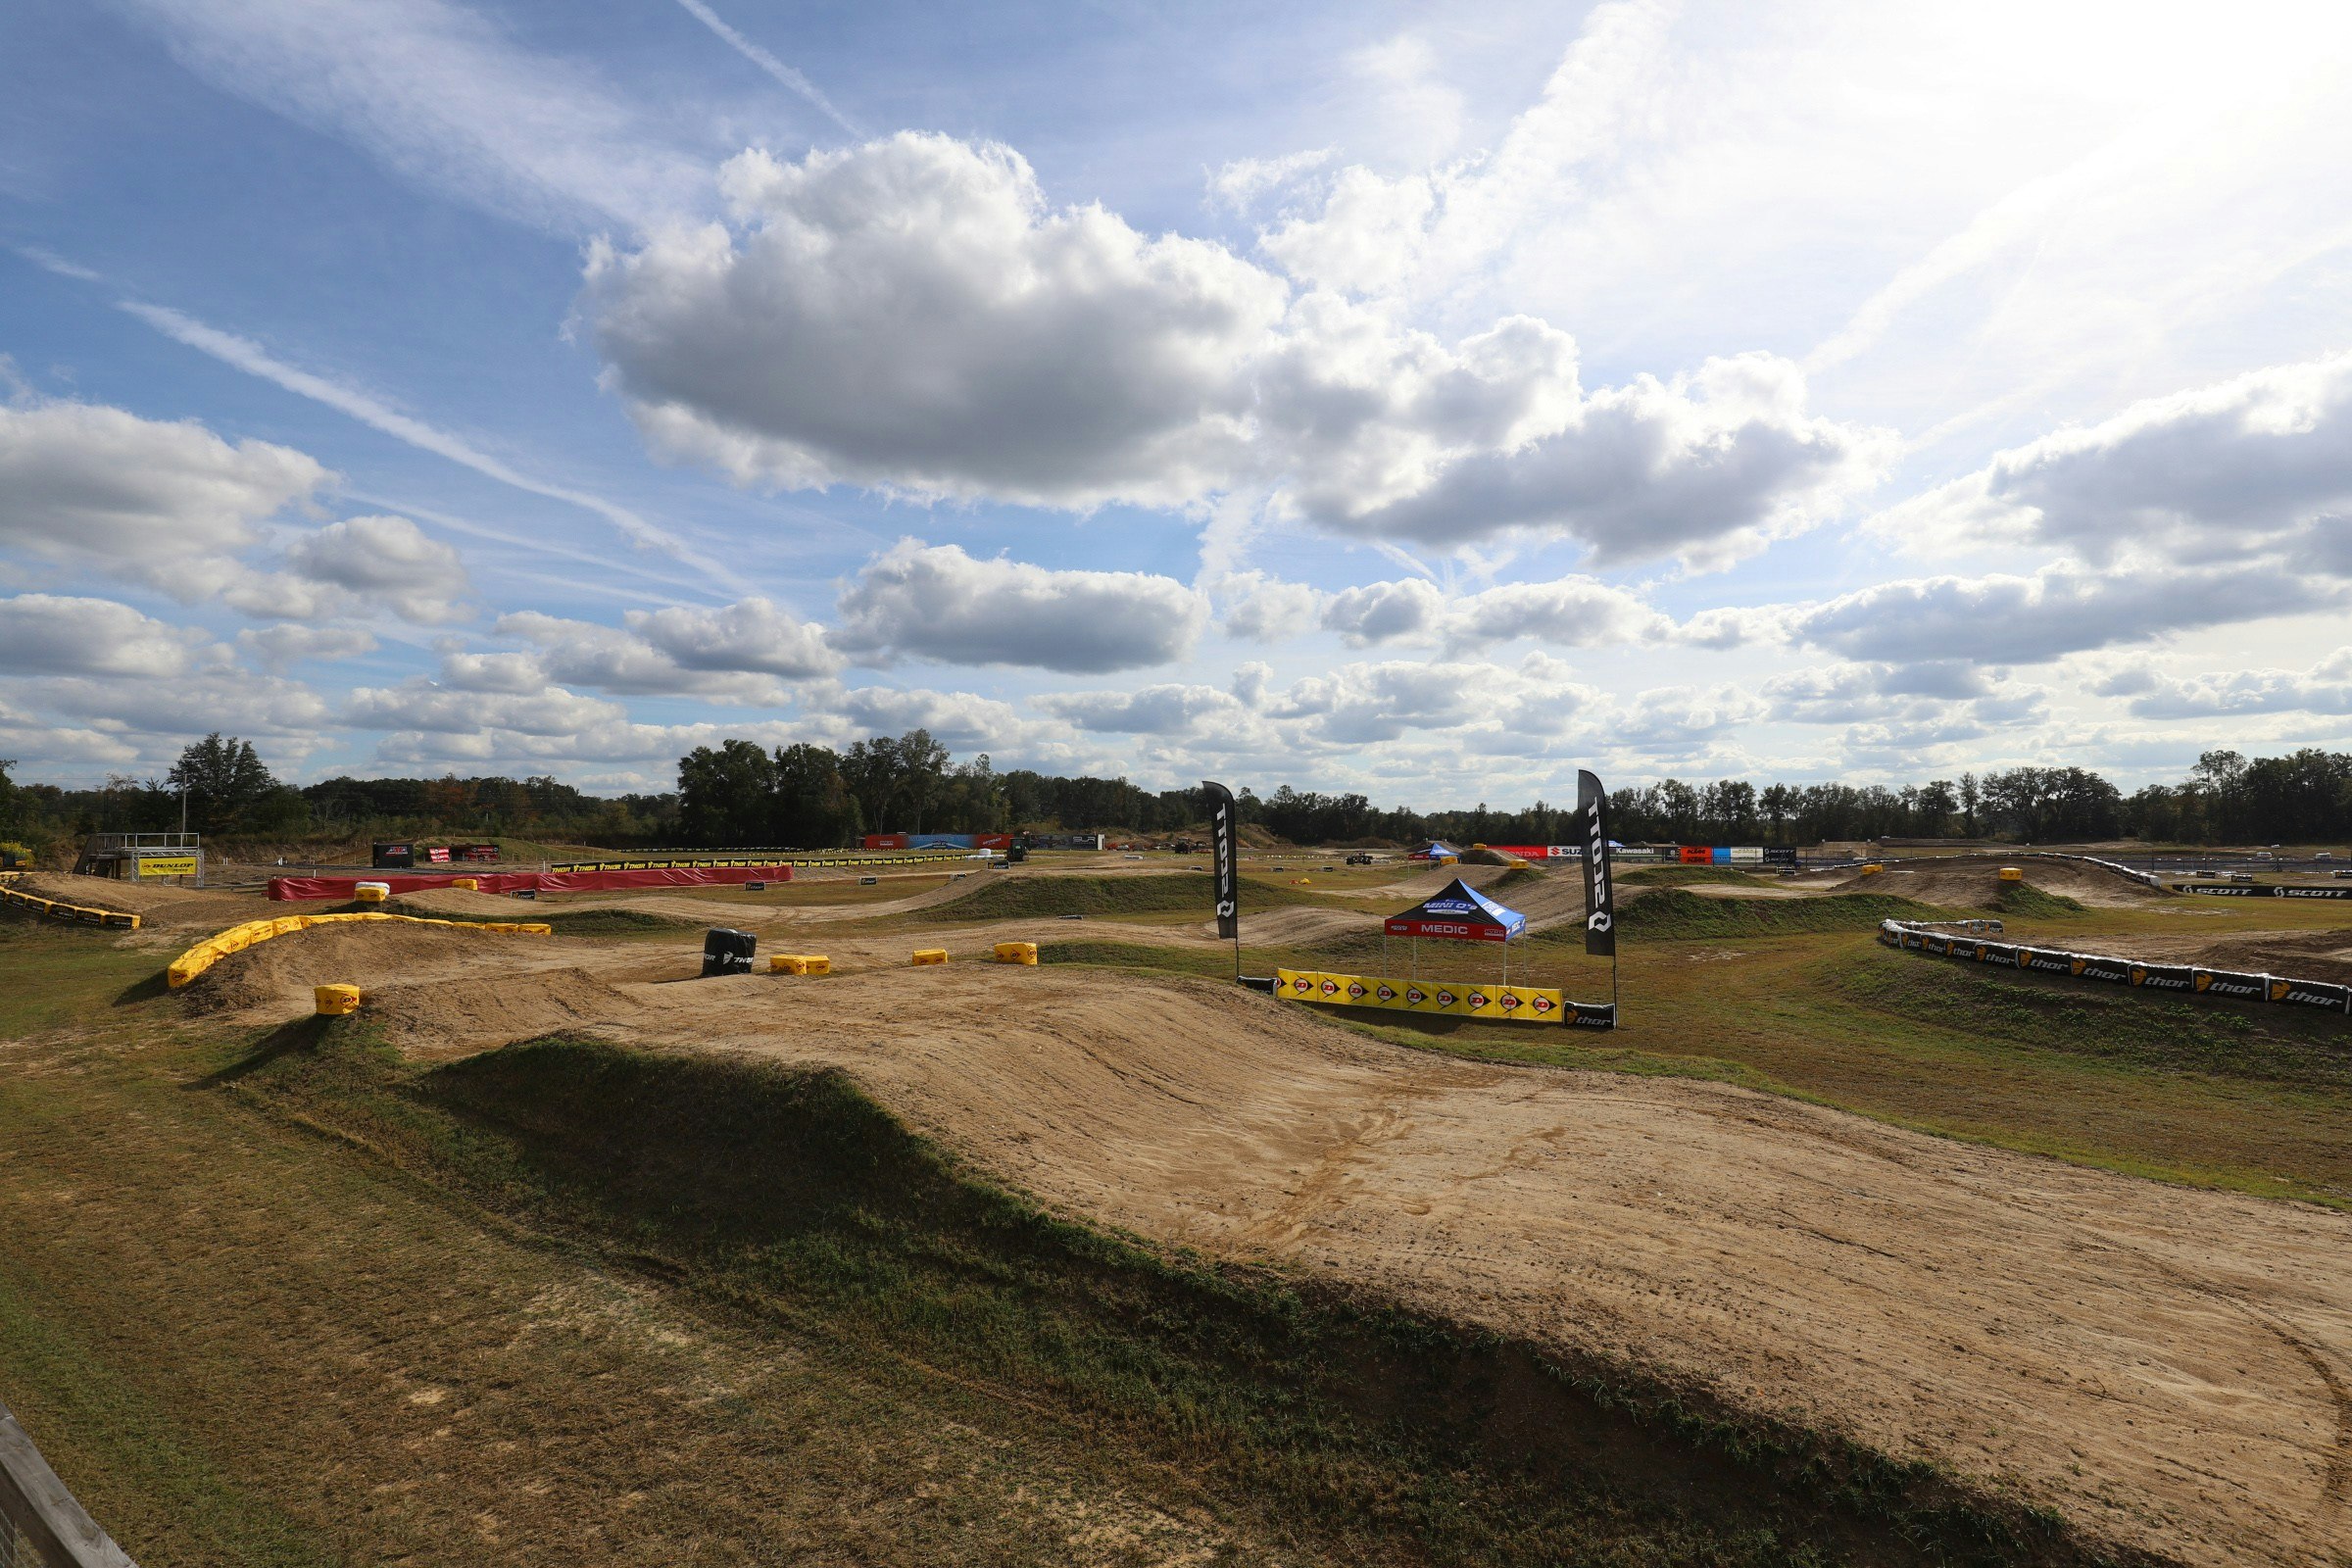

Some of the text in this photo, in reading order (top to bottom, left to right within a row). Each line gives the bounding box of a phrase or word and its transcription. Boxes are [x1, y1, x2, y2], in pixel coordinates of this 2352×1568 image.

[1421, 925, 1468, 935] MEDIC
[1953, 948, 1975, 957] thor
[1985, 954, 2015, 964] thor
[2030, 959, 2069, 970] thor
[2083, 967, 2127, 980] thor
[2145, 976, 2190, 988] thor
[2210, 981, 2262, 995] thor
[2286, 991, 2343, 1005] thor
[1575, 1016, 1611, 1026] thor
